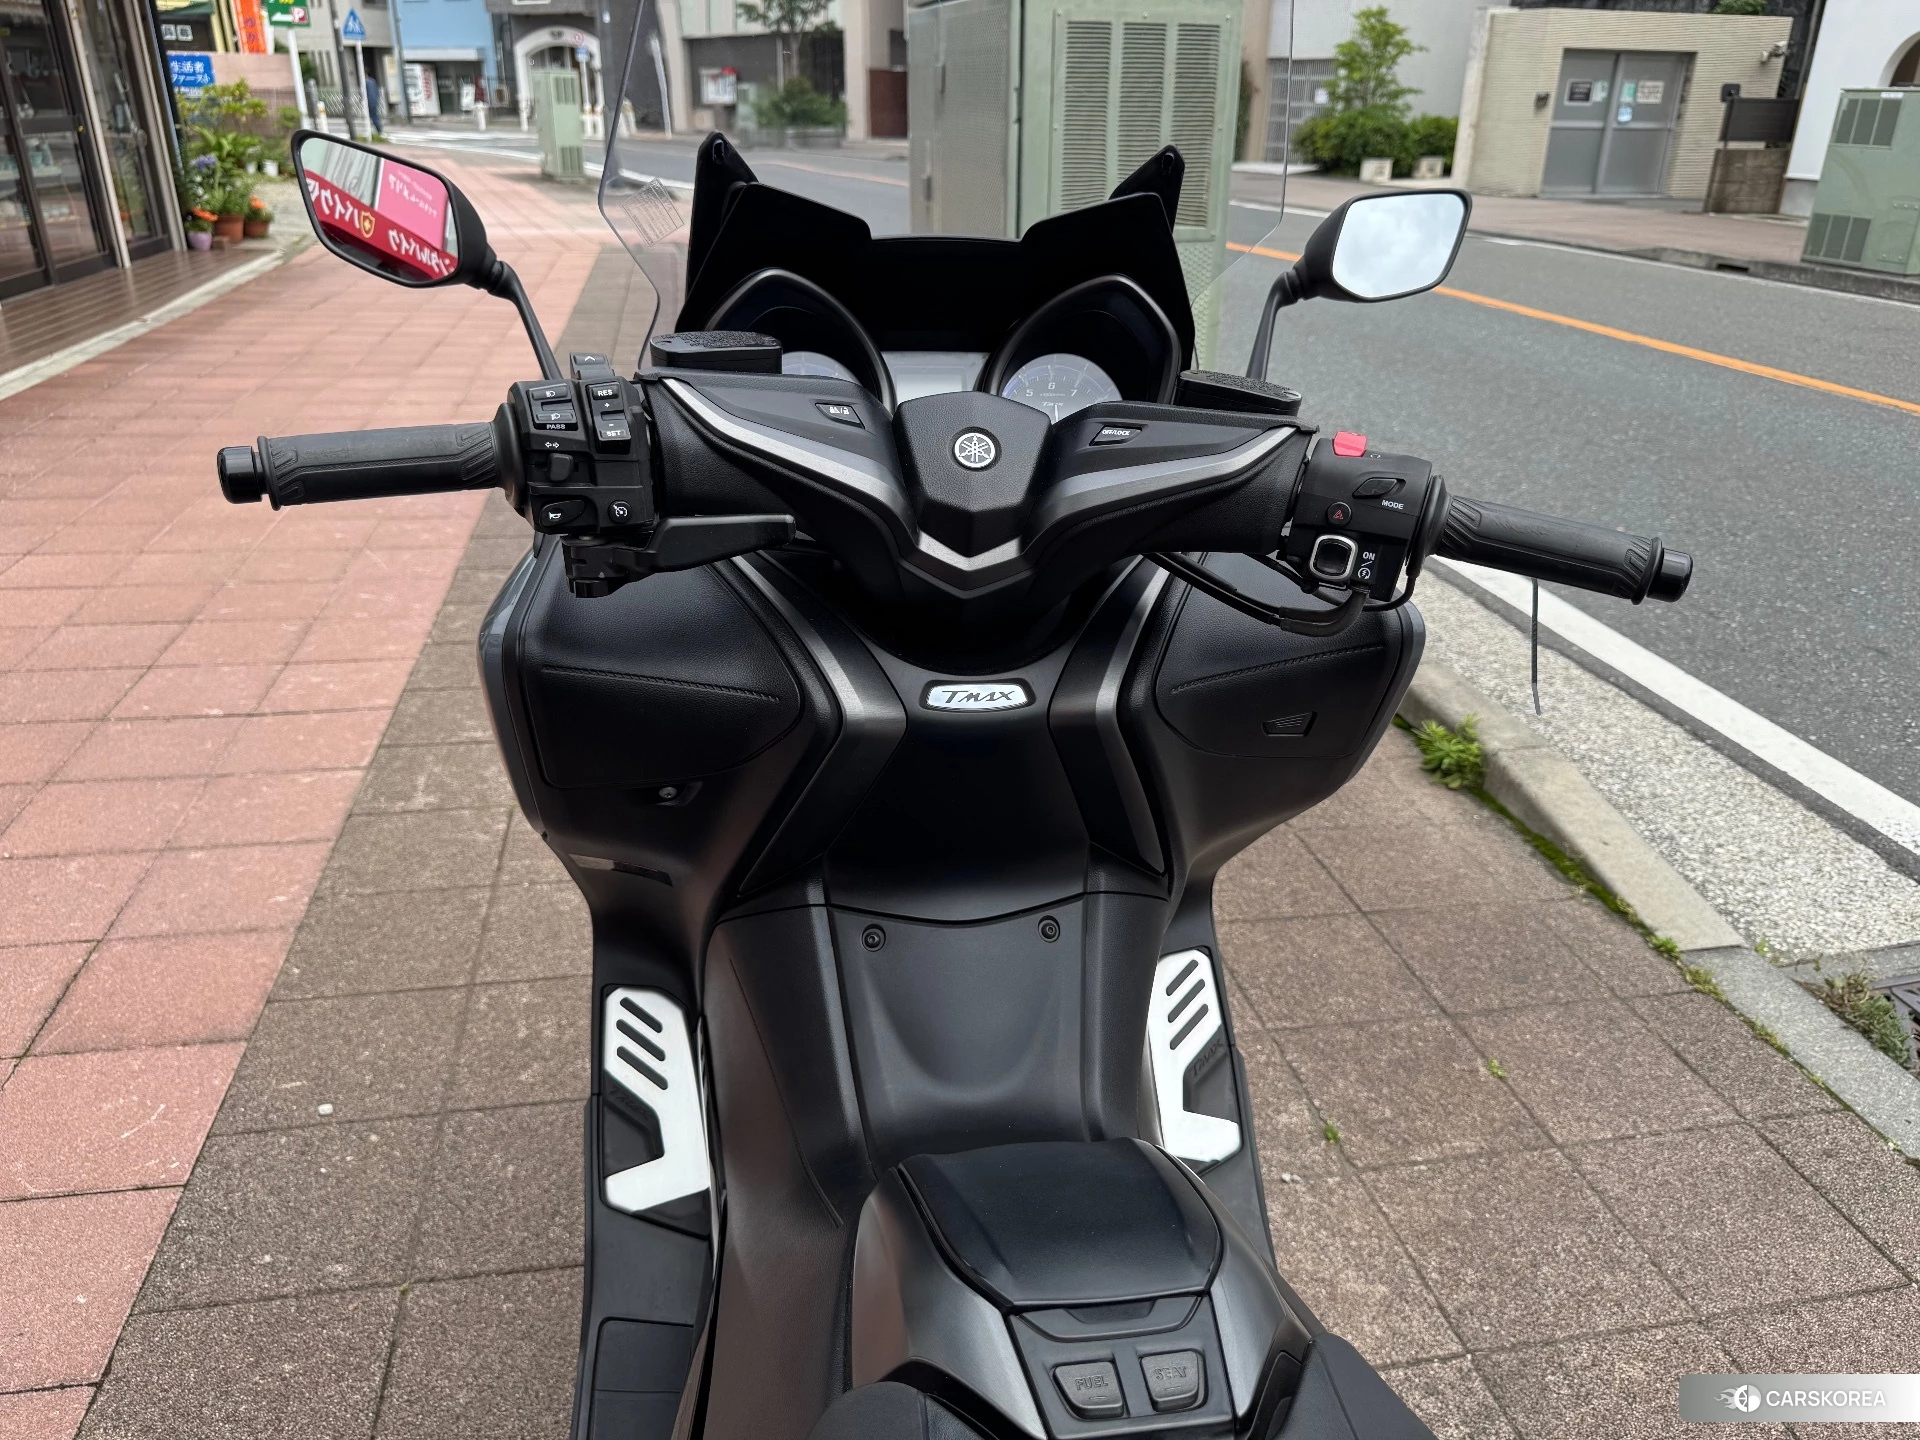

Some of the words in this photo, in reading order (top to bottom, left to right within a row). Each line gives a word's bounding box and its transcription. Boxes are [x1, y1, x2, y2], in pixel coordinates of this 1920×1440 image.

[170, 60, 205, 74] 生活者
[1047, 382, 1056, 390] 6
[597, 389, 613, 397] RES
[1025, 389, 1034, 397] 5
[1070, 389, 1078, 397] 7
[1381, 499, 1405, 510] MODE
[1362, 551, 1376, 561] ON
[941, 690, 1015, 704] TMAX
[1154, 1366, 1187, 1381] SEAT
[1074, 1374, 1109, 1391] FUEL
